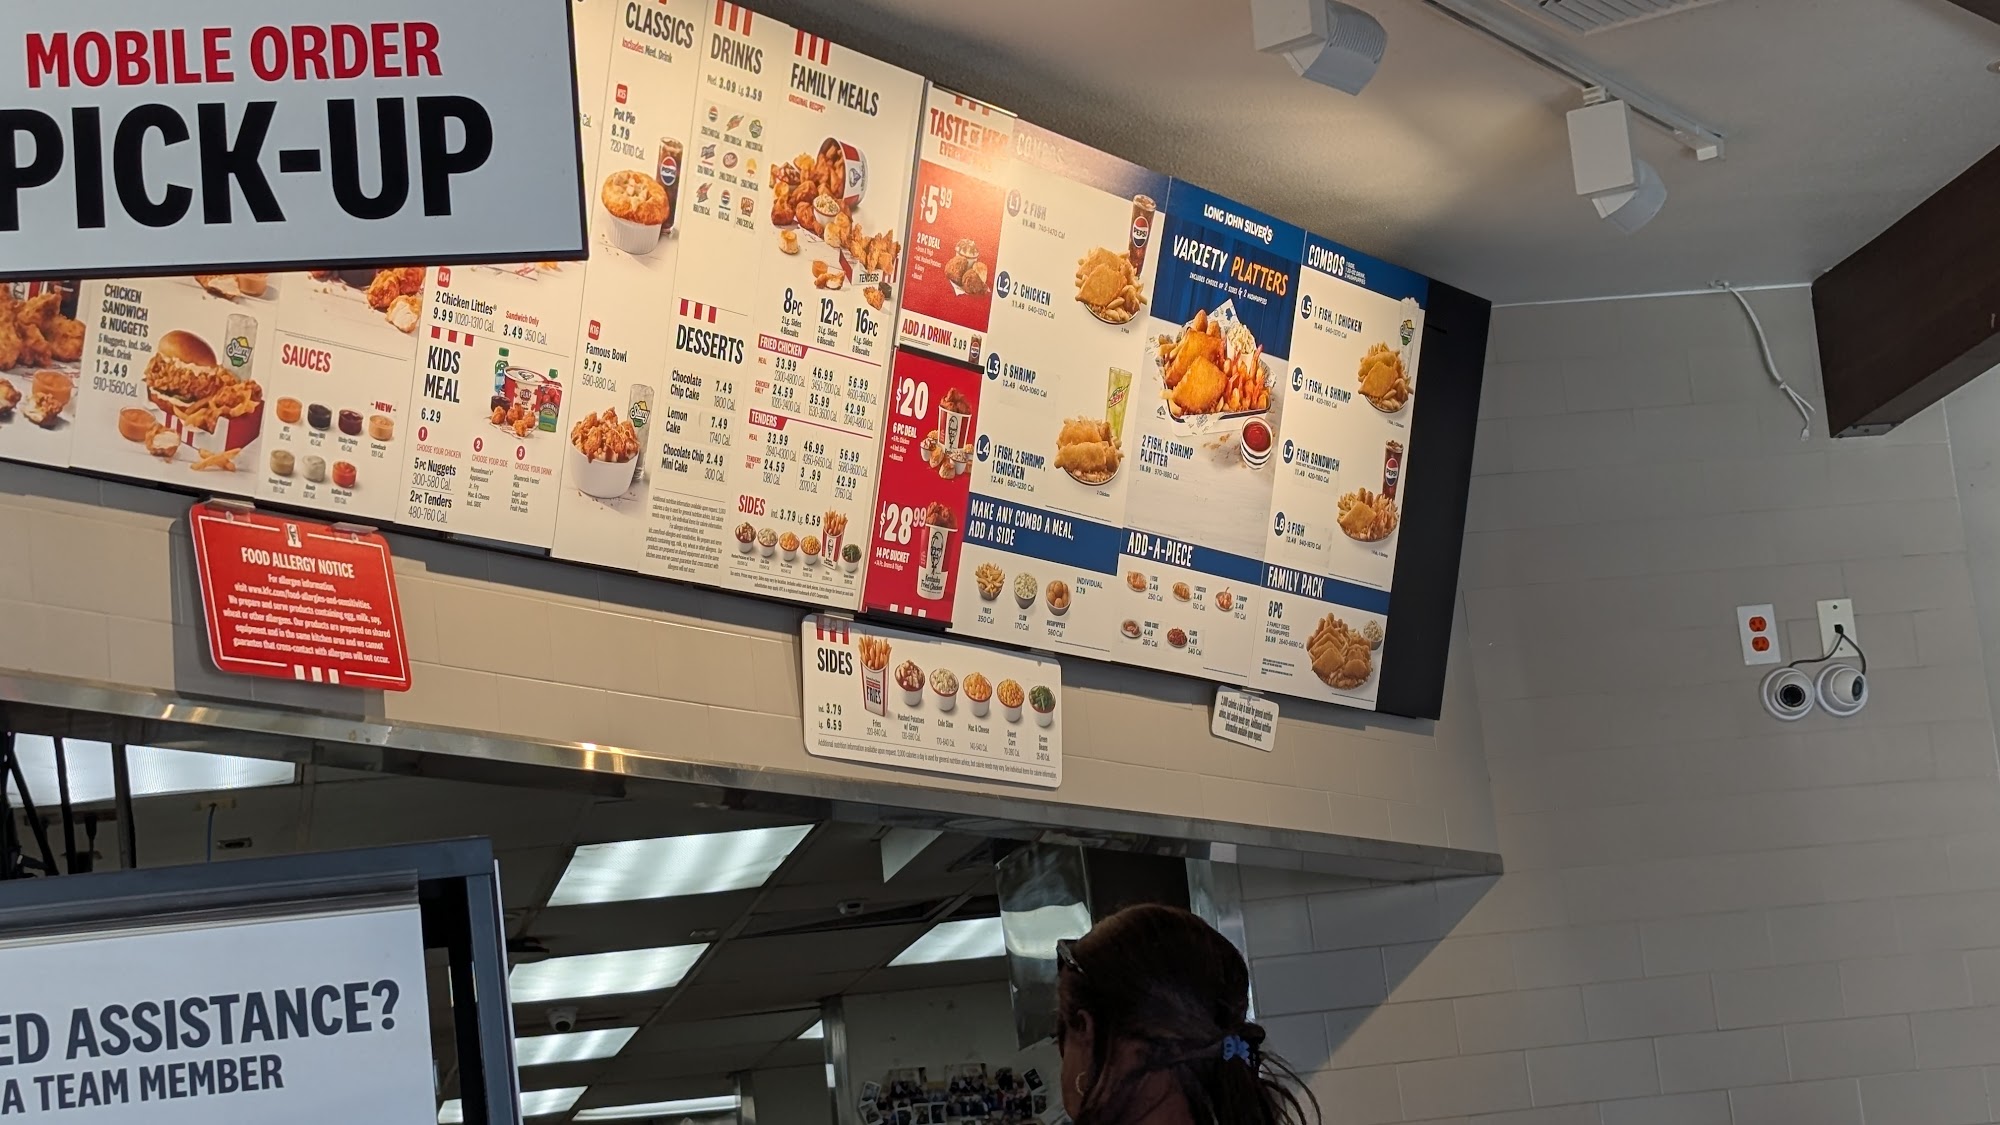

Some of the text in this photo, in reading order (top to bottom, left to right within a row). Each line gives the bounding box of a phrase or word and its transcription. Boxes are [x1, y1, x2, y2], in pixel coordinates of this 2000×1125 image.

[625, 2, 694, 48] CLASSICS
[26, 22, 443, 88] MOBILE ORDER
[710, 32, 764, 75] DRINKS
[790, 62, 880, 116] FAMILY MEALS
[613, 107, 636, 126] Pot Pie
[930, 108, 970, 146] TASTE
[611, 124, 630, 140] 8.79
[0, 95, 494, 231] PICK-UP
[1204, 204, 1274, 244] LONG JOHN SILVER'S
[1173, 234, 1289, 296] VARIETY PLATTERS
[1308, 244, 1346, 277] COMBOS
[104, 284, 142, 304] CHICKEN
[997, 276, 1051, 306] L2 2 CHICKEN
[102, 300, 148, 322] SANDWICH
[1302, 298, 1312, 314] L5
[1318, 306, 1333, 324] FISH,
[1338, 313, 1362, 334] CHICKEN
[100, 316, 149, 338] & NUGGETS
[502, 324, 548, 346] 3.49 350 Cal.
[902, 318, 920, 336] ADD
[920, 324, 926, 338] A
[927, 326, 952, 346] DRINK
[586, 342, 628, 363] Famous Bowl
[676, 324, 745, 365] DESSERTS
[760, 336, 803, 357] FRIED CHICKEN
[952, 338, 968, 350] 3.09
[96, 359, 128, 378] 13.49
[282, 343, 332, 373] SAUCES
[427, 345, 461, 375] KIDS
[584, 358, 603, 374] 9.79
[775, 357, 798, 372] 33.99
[672, 369, 702, 388] Chocolate
[812, 366, 834, 382] 46.99
[988, 358, 1036, 384] L3 6 SHRIMP
[423, 374, 460, 404] MEAL
[670, 384, 700, 401] Chip Cake
[716, 380, 734, 394] 7.49
[772, 384, 794, 399] 24.59
[848, 376, 869, 391] 56.99
[1292, 372, 1303, 387] L6
[1308, 379, 1324, 397] FISH,
[1324, 385, 1329, 397] 4
[1329, 386, 1352, 404] SHRIMP
[809, 393, 830, 408] 35.99
[896, 376, 929, 420] $20
[421, 407, 441, 424] 6.29
[667, 406, 688, 422] Lemon
[752, 410, 778, 428] TENDERS
[844, 402, 866, 416] 42.99
[666, 421, 681, 435] Cake
[711, 416, 728, 430] 7.49
[767, 432, 789, 446] 33.99
[803, 440, 824, 455] 46.99
[1142, 434, 1194, 460] 2 FISH, 6 SHRIMP
[416, 443, 462, 459] CHOOSE YOUR CHICKEN
[663, 443, 705, 463] Chocolate Chip
[706, 452, 724, 466] 2.49
[839, 448, 860, 463] 56.99
[976, 440, 990, 456] L4
[998, 446, 1014, 464] FISH,
[1016, 450, 1020, 464] 2
[1021, 450, 1046, 472] SHRIMP,
[1140, 448, 1168, 468] PLATTER
[1283, 445, 1294, 459] L7
[1296, 448, 1310, 464] FISH
[1310, 452, 1340, 472] SANDWICH
[660, 456, 689, 474] Mini Cake
[764, 458, 786, 473] 24.59
[996, 460, 1026, 480] CHICKEN
[412, 472, 452, 492] 300-580 Cal.
[836, 474, 857, 489] 42.99
[408, 505, 448, 524] 480-760 Cal.
[738, 494, 766, 517] SIDES
[970, 499, 995, 520] MAKE
[996, 506, 1014, 525] ANY
[1014, 510, 1042, 532] COMBO
[1044, 517, 1050, 534] A
[1052, 518, 1074, 541] MEAL,
[1275, 516, 1306, 538] L8 3 FISH
[968, 520, 1016, 546] ADD A SIDE
[1126, 531, 1193, 568] ADD-A-PIECE
[240, 546, 356, 579] FOOD ALLERGY NOTICE
[268, 574, 278, 583] For
[1266, 565, 1300, 592] FAMILY
[1300, 576, 1325, 598] PACK
[817, 646, 853, 676] SIDES
[866, 686, 882, 706] FRIES
[872, 719, 882, 728] Fries
[65, 979, 400, 1061] ASSISTANCE?
[2, 1054, 285, 1115] A TEAM MEMBER
